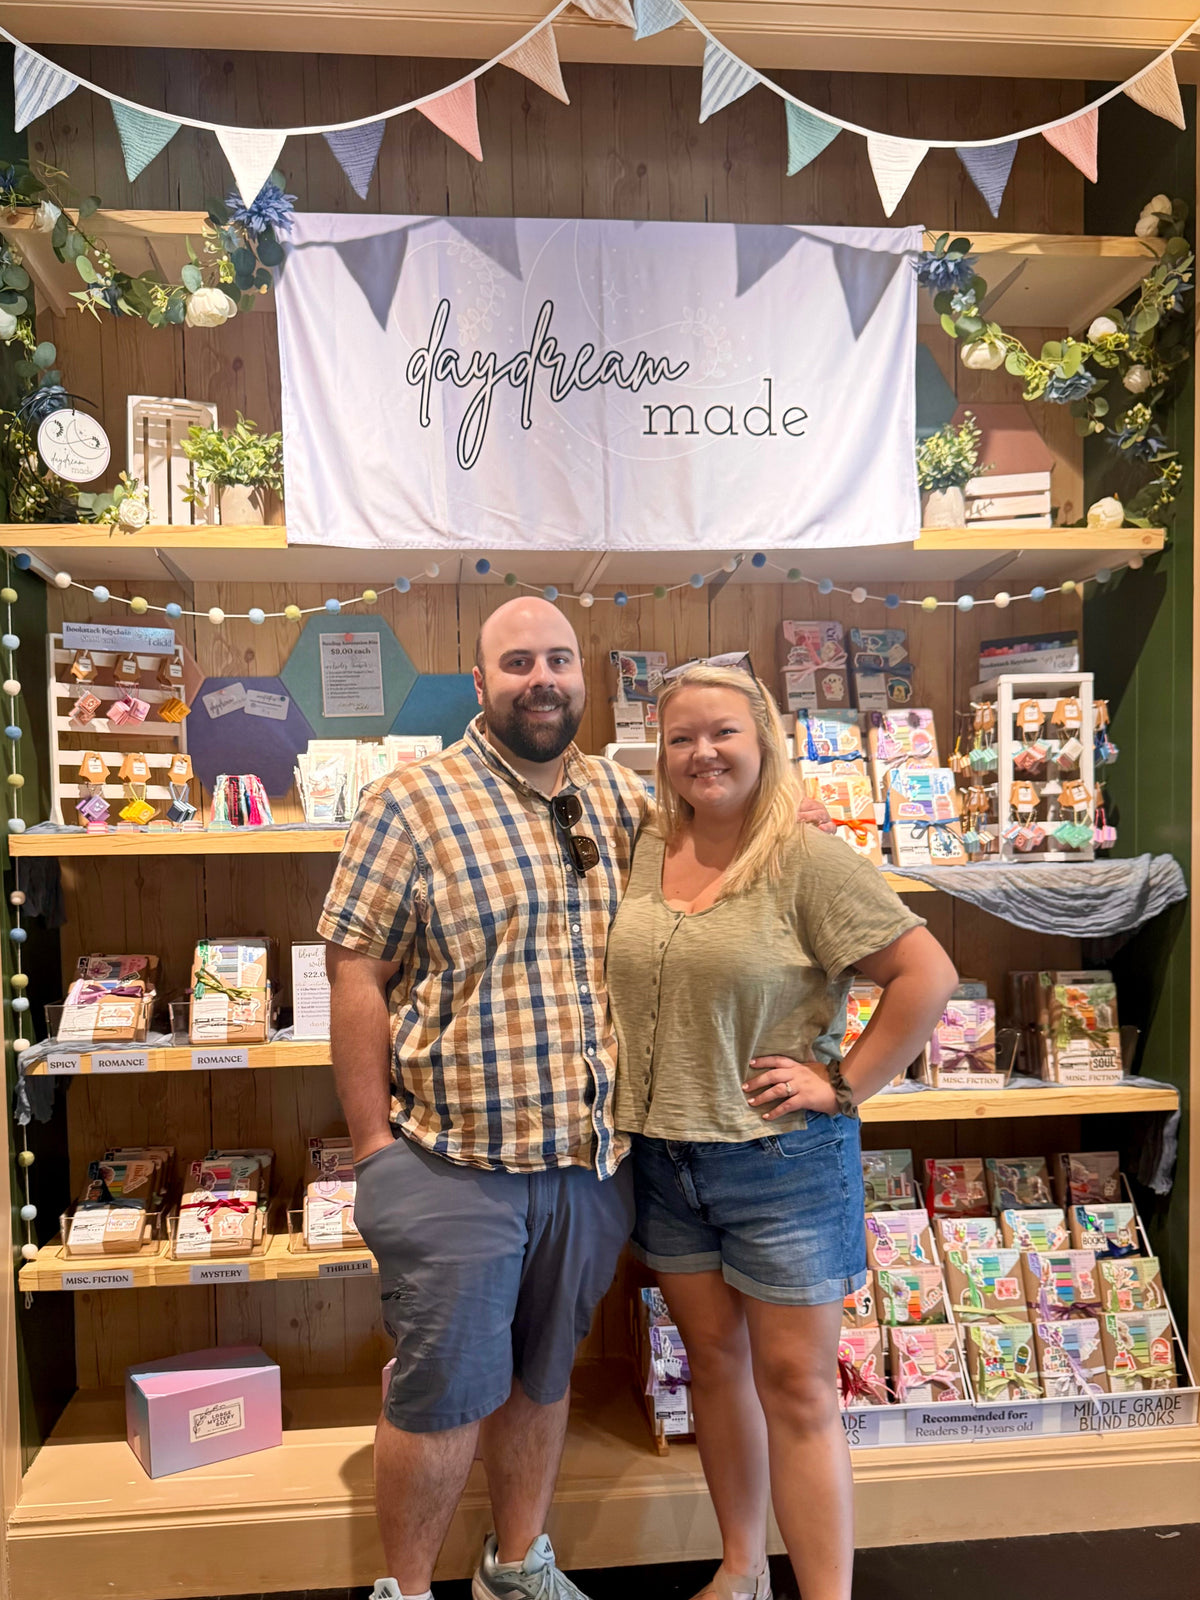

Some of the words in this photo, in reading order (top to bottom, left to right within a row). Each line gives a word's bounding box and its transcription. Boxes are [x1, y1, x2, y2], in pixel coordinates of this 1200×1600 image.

[406, 299, 689, 470] daydream
[642, 378, 809, 436] made
[303, 970, 327, 979] $22.0
[50, 1061, 77, 1069] SPICY
[98, 1058, 145, 1067] ROMANCE
[197, 1055, 243, 1065] ROMANCE
[325, 1263, 369, 1273] THRILLER
[200, 1269, 243, 1279] MYSTERY
[66, 1276, 91, 1285] MISC.
[92, 1275, 129, 1284] FICTION
[1074, 1399, 1128, 1417] MIDDLE
[1132, 1395, 1183, 1413] GRADE
[207, 1414, 234, 1424] MYSTERY
[922, 1410, 1006, 1424] Recommended
[1007, 1410, 1028, 1420] for:
[1079, 1413, 1121, 1431] BLIND
[1127, 1410, 1176, 1427] BOOKS
[915, 1426, 959, 1437] Readers
[961, 1425, 984, 1435] 9-14
[985, 1423, 1015, 1435] years
[1016, 1421, 1034, 1431] old
